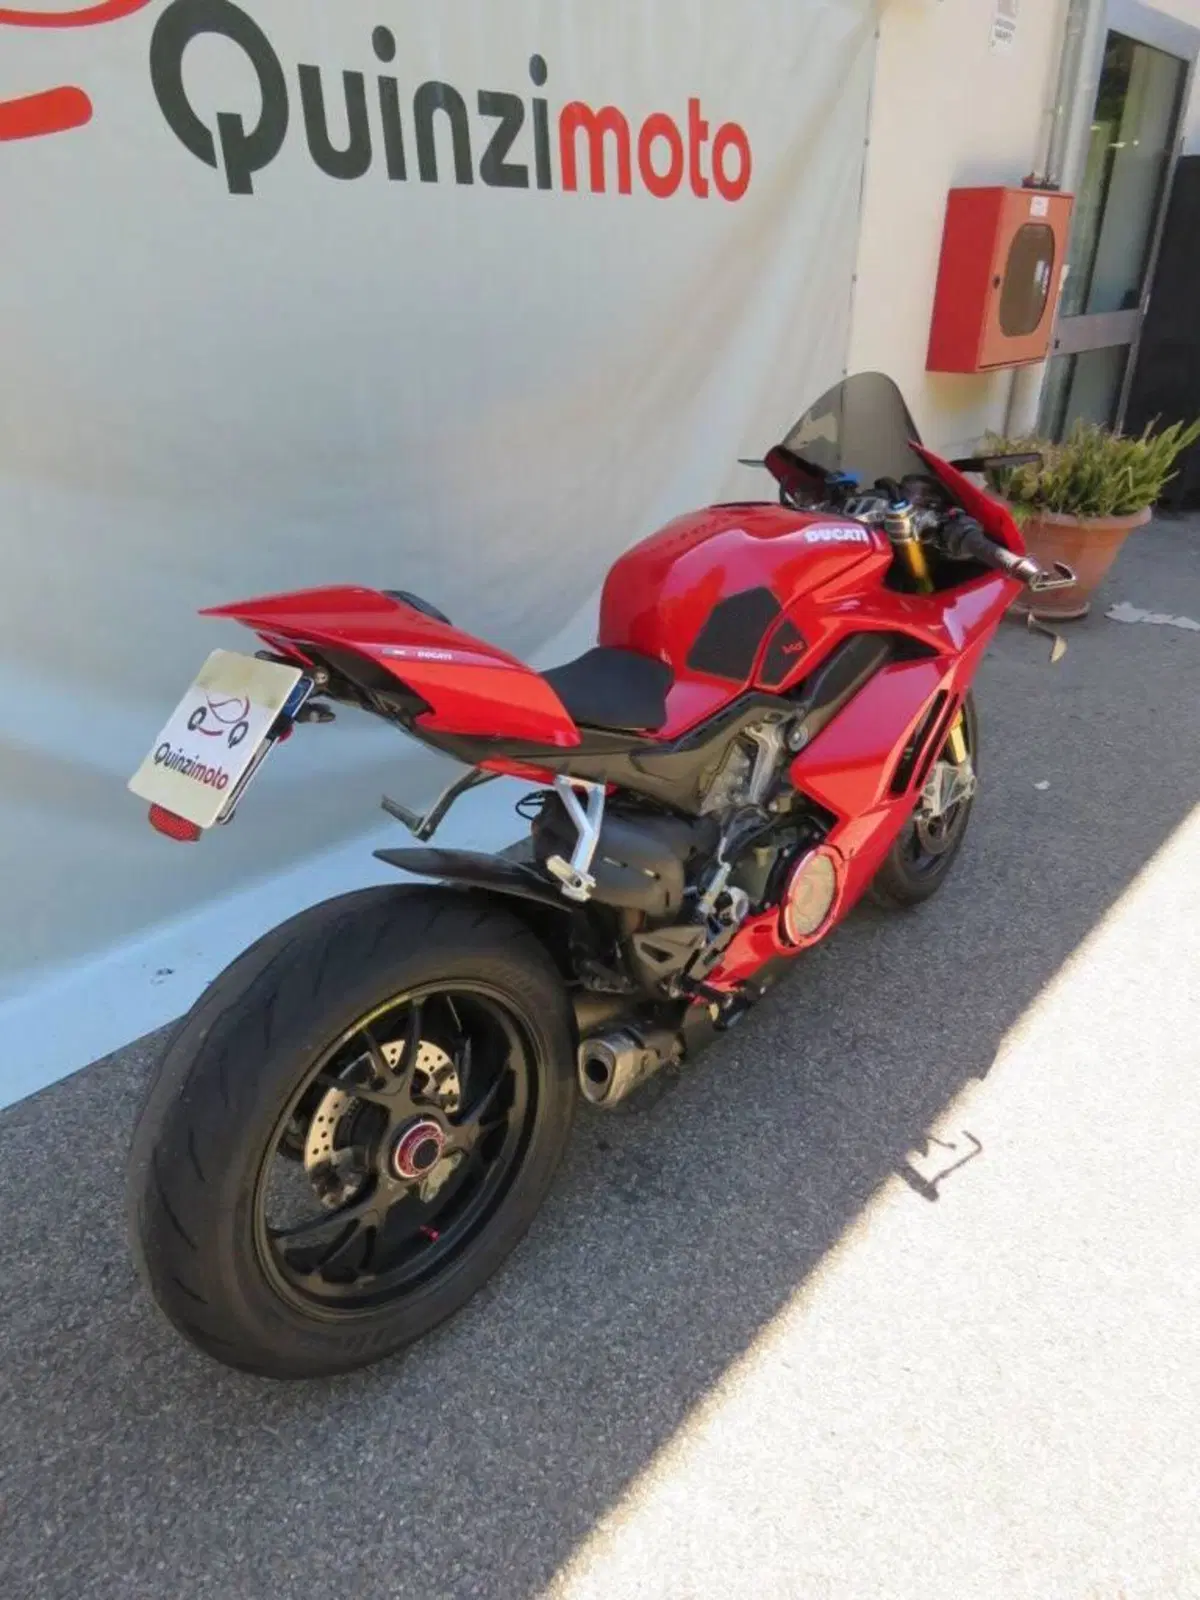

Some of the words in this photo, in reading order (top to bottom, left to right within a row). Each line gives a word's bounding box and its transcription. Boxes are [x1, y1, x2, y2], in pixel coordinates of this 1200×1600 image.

[149, 0, 751, 201] Quinzimoto
[805, 528, 869, 543] DUCATI
[154, 742, 229, 790] Quinzimoto
